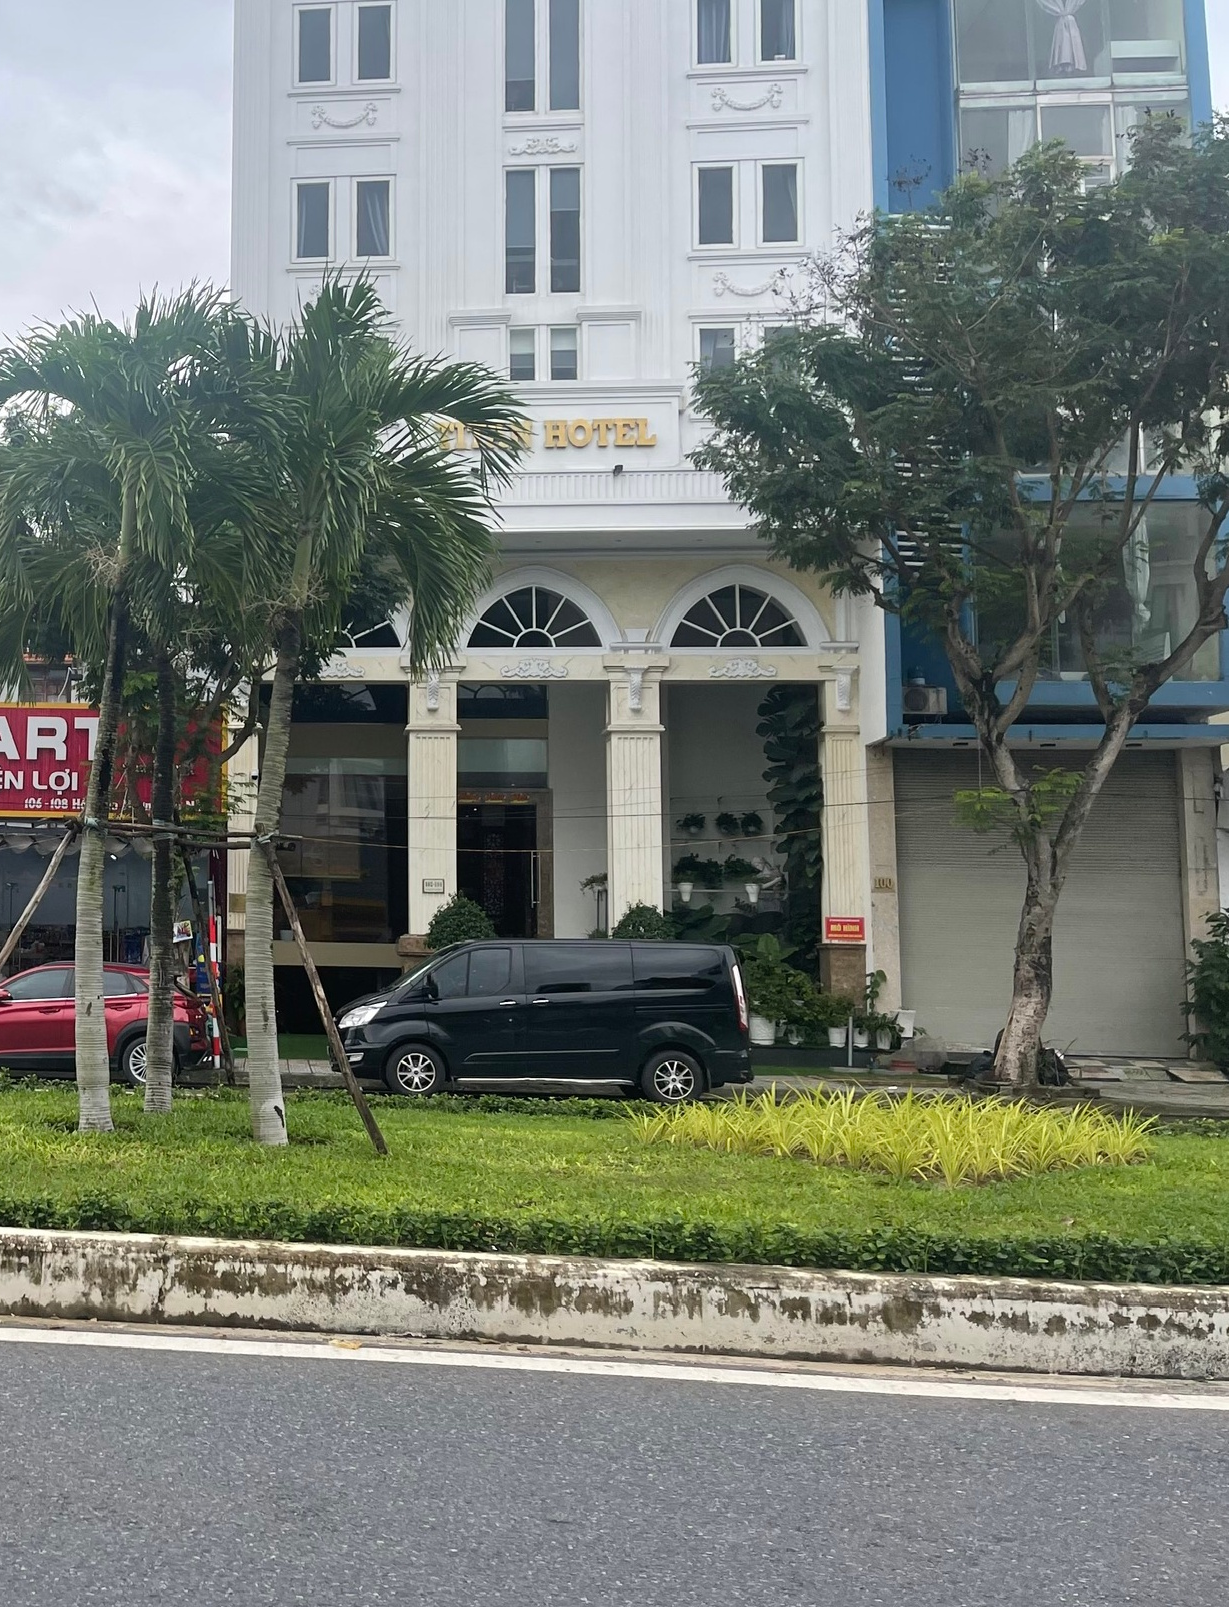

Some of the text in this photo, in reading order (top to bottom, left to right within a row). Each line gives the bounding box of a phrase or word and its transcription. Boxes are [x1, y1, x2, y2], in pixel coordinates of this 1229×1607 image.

[544, 418, 658, 448] HOTEL
[32, 769, 78, 795] LỢI
[875, 878, 893, 889] 100
